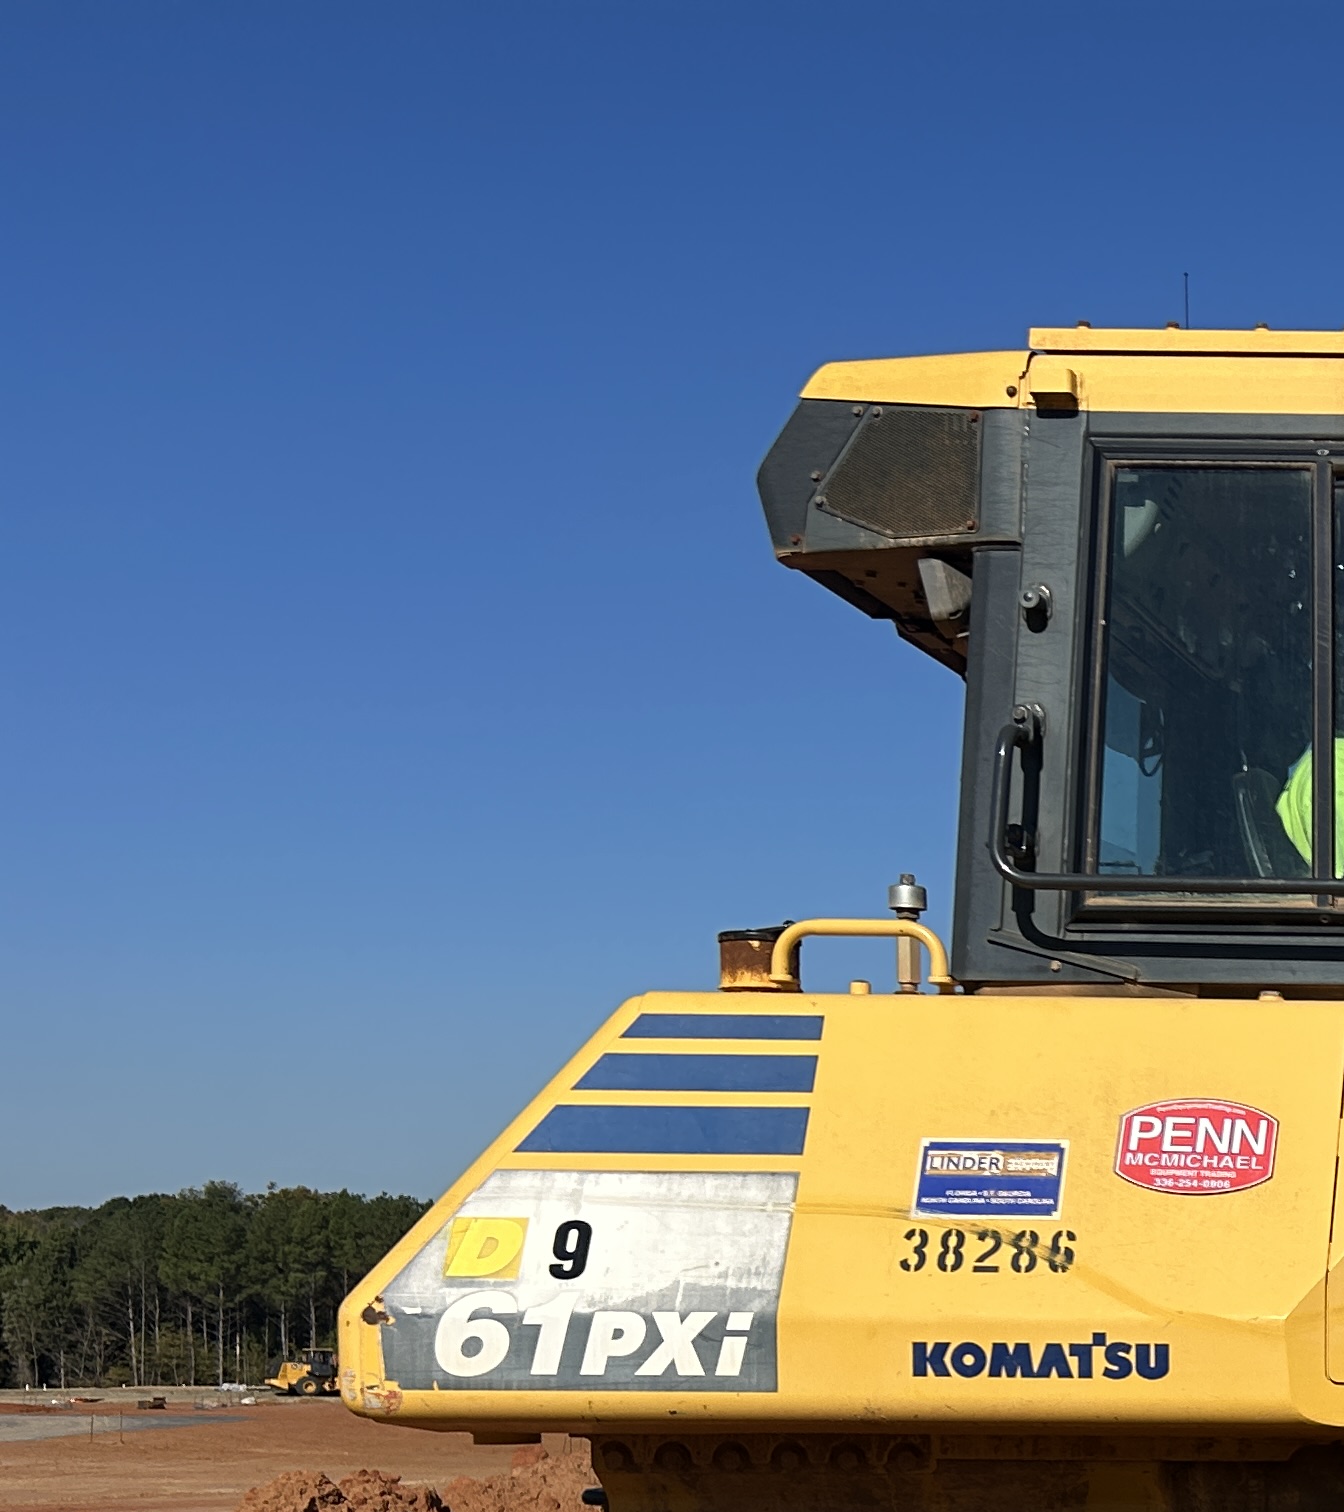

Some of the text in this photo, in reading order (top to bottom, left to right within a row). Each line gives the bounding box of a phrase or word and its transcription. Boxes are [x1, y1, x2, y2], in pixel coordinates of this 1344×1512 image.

[1128, 1115, 1268, 1155] PENN
[929, 1156, 1001, 1171] LINDER
[1124, 1152, 1263, 1170] MCMICHAEL
[445, 1218, 592, 1280] D 9
[899, 1228, 1077, 1273] 38286
[435, 1289, 755, 1376] 61PXi
[911, 1332, 1170, 1380] KOMATSU
